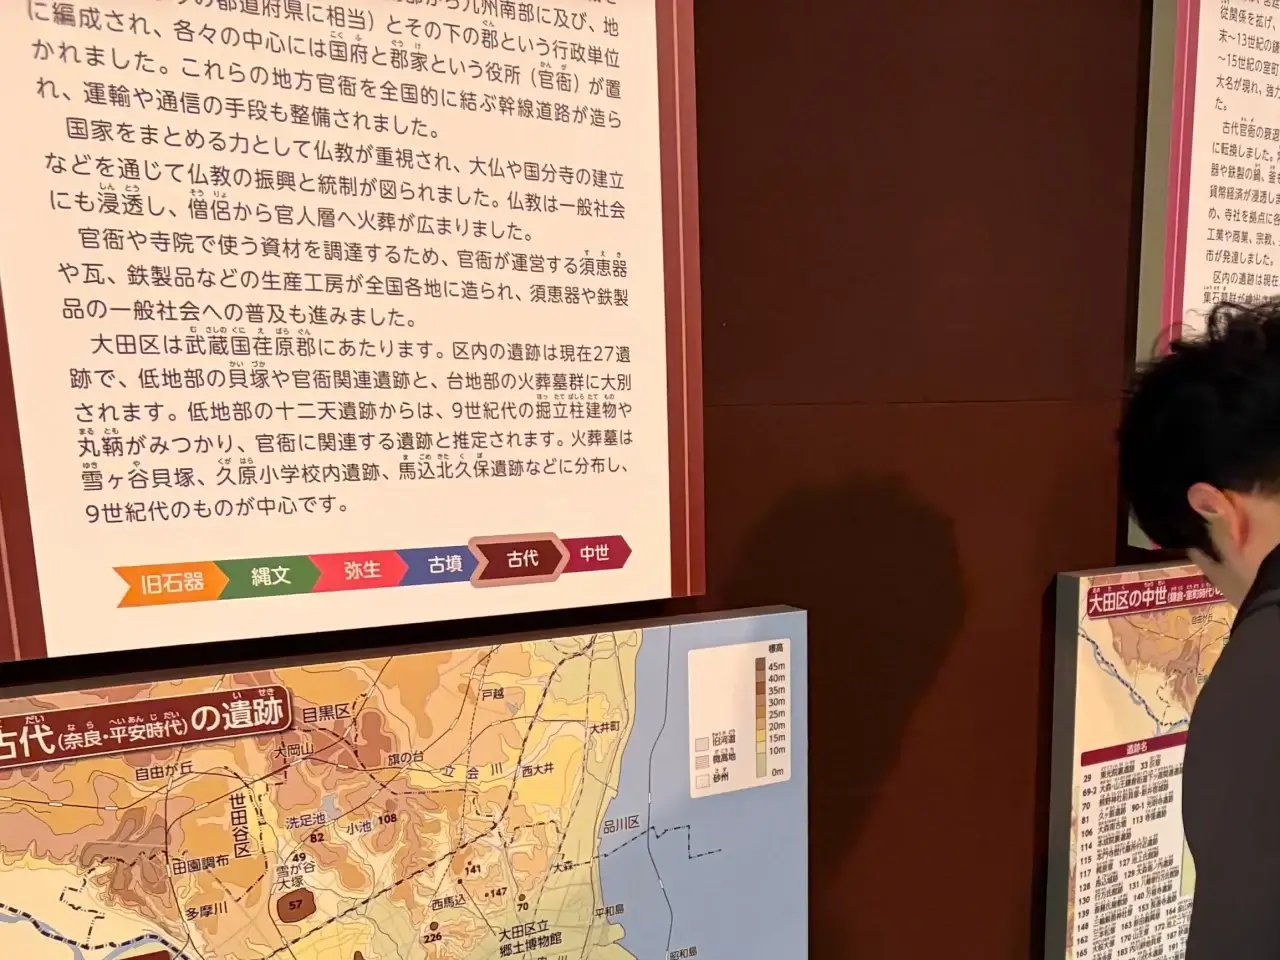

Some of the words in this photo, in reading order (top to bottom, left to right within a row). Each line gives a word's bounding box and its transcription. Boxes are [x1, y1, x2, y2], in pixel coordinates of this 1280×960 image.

[33, 38, 622, 129] かれました。これらの地方官衙を全国的に結ぶ幹線道路が造ら
[37, 76, 438, 139] れ、運輸や通信の手段も整備されました。
[66, 115, 625, 190] 国家をまとめる力として仏教が重視され、大仏や国分寺の建立
[46, 152, 626, 220] などを通じて仏教の振興と統制が図られました。仏教は一般社会
[50, 190, 533, 242] にも浸透し、僧侶から官人層へ火葬が広まりました。
[78, 228, 627, 278] 官衙や寺院で使う資材を調達するため、官衙が運営する須恵器
[58, 262, 629, 307] や瓦、鉄製品などの生産工房が全国各地に造られ、須恵器や鉄製
[62, 297, 415, 328] 品の一般社会への普及も進みました。
[91, 332, 632, 364] 大田区は武蔵国荏原郡にあたります。区内の遺跡は現在27遺
[70, 367, 632, 392] 跡で、低地部の貝塚や官衙関連遺跡と、台地部の火葬墓群に大別
[75, 400, 633, 424] されます。低地部の十二天遺跡からは、9世紀代の掘立柱建物や
[78, 429, 633, 457] 丸鞆がみつかり、官衙に関連する遺跡と推定されます。火葬墓は
[81, 457, 629, 491] 雪ヶ谷貝塚、久原小学校内遺跡、馬込北久保遺跡などに分布し、
[86, 495, 347, 523] 9世紀代のものが中心です。
[506, 549, 539, 569] 古代
[579, 543, 611, 563] 中世
[344, 559, 382, 581] 弥生
[427, 554, 464, 575] 古墳
[141, 573, 204, 595] 旧石器
[251, 565, 291, 587] 縄文
[768, 661, 785, 671] 45m
[768, 673, 785, 683] 40m
[482, 689, 505, 701] 戸越
[302, 703, 351, 724] 目黒区
[589, 721, 620, 735] 大井町
[768, 720, 785, 731] 20m
[274, 743, 314, 760] 大岡山
[388, 751, 424, 767] 旗の台
[768, 745, 785, 755] 10m
[135, 761, 194, 782] 自由が丘
[444, 763, 503, 780] 立会川
[522, 763, 554, 778] 西大井
[229, 793, 251, 858] 世田谷区
[286, 813, 326, 830] 洗足池
[346, 820, 372, 834] 小池
[377, 813, 397, 825] 108
[603, 815, 640, 834] 品川区
[173, 854, 230, 876] 田園調布
[465, 864, 482, 875] 141
[553, 861, 574, 874] 大森
[277, 875, 304, 891] 大塚
[185, 902, 228, 921] 多摩川
[289, 900, 302, 911] 57
[432, 894, 466, 910] 西馬込
[595, 903, 625, 918] 平和島
[424, 931, 442, 943] 226
[499, 920, 549, 942] 大田区立
[500, 931, 562, 957] 郷土博物館
